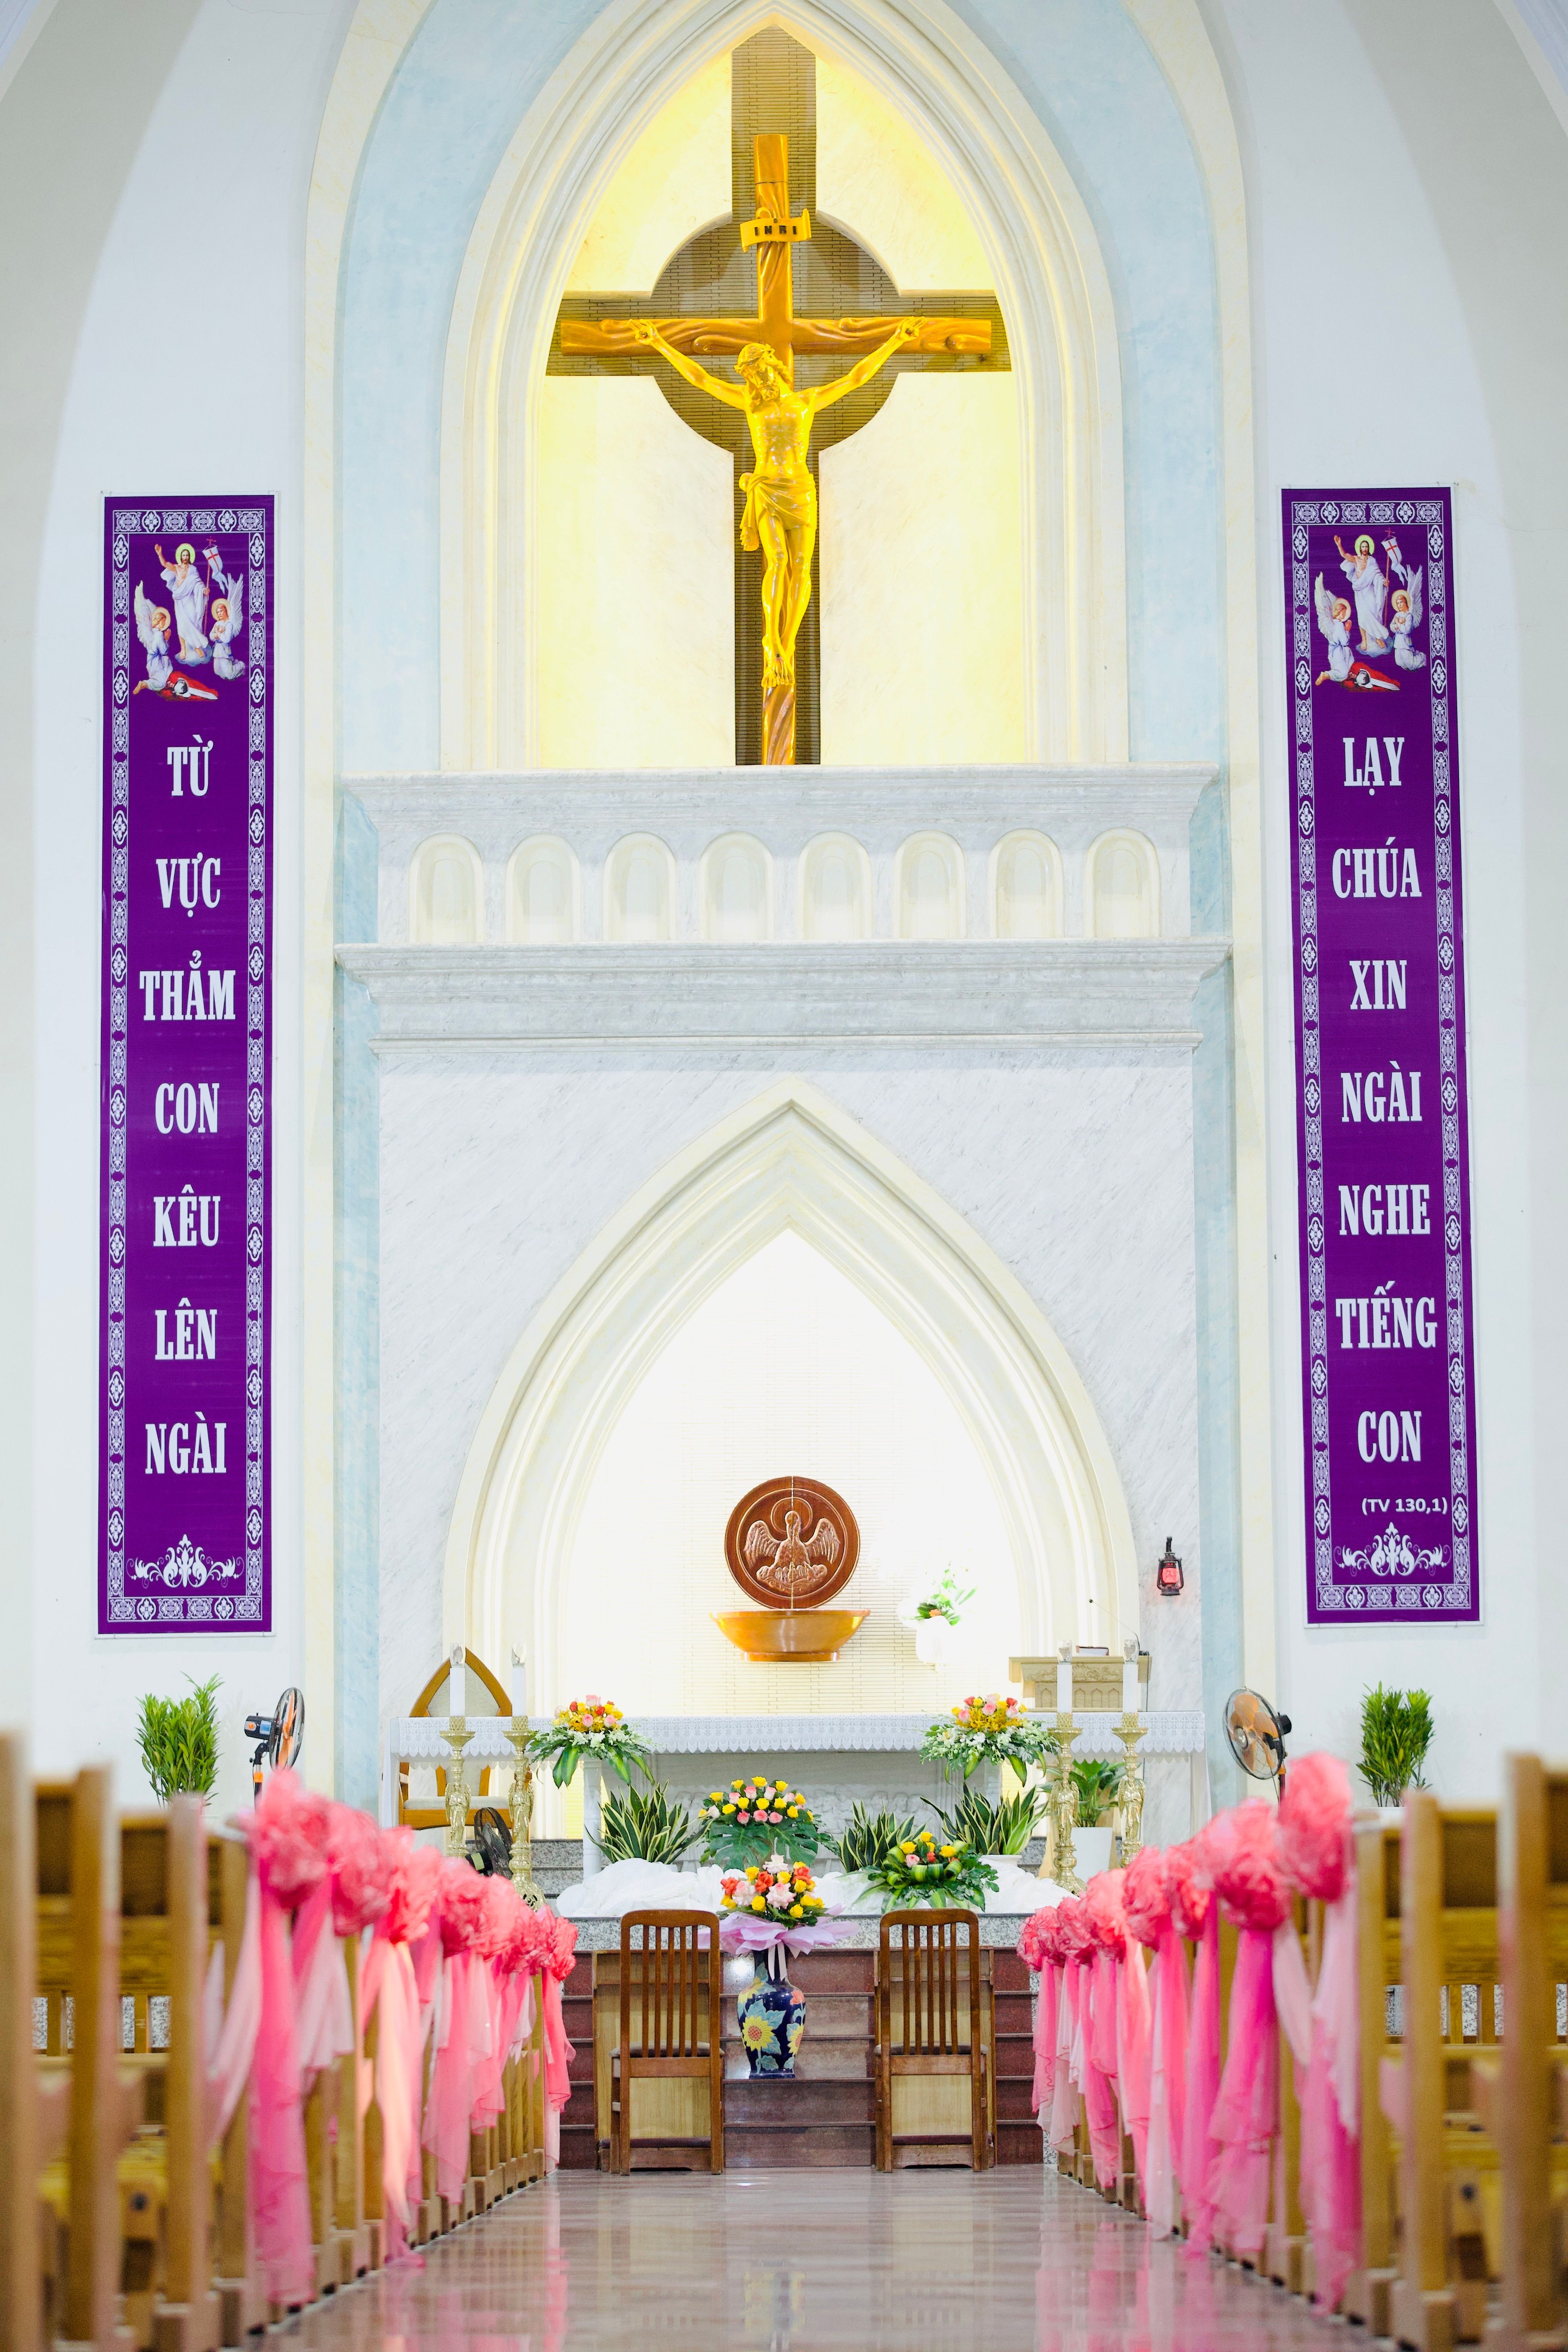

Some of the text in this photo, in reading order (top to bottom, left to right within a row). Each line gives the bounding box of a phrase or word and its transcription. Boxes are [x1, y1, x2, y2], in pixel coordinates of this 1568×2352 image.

[167, 735, 214, 796] TỪ
[1343, 737, 1405, 796] LẠY
[156, 852, 220, 917] VỰC
[1332, 837, 1422, 898] CHÚA
[139, 950, 236, 1021] THẲM
[1349, 960, 1407, 1010] XIN
[155, 1083, 220, 1134] CON
[1341, 1061, 1422, 1122] NGÀI
[153, 1184, 221, 1246] KÊU
[1338, 1184, 1430, 1235] NGHE
[155, 1297, 217, 1360] LÊN
[1335, 1280, 1438, 1348] TIẾNG
[145, 1411, 227, 1474] NGÀI
[1357, 1411, 1421, 1463] CON
[1362, 1497, 1448, 1515] (TV 130,1)
